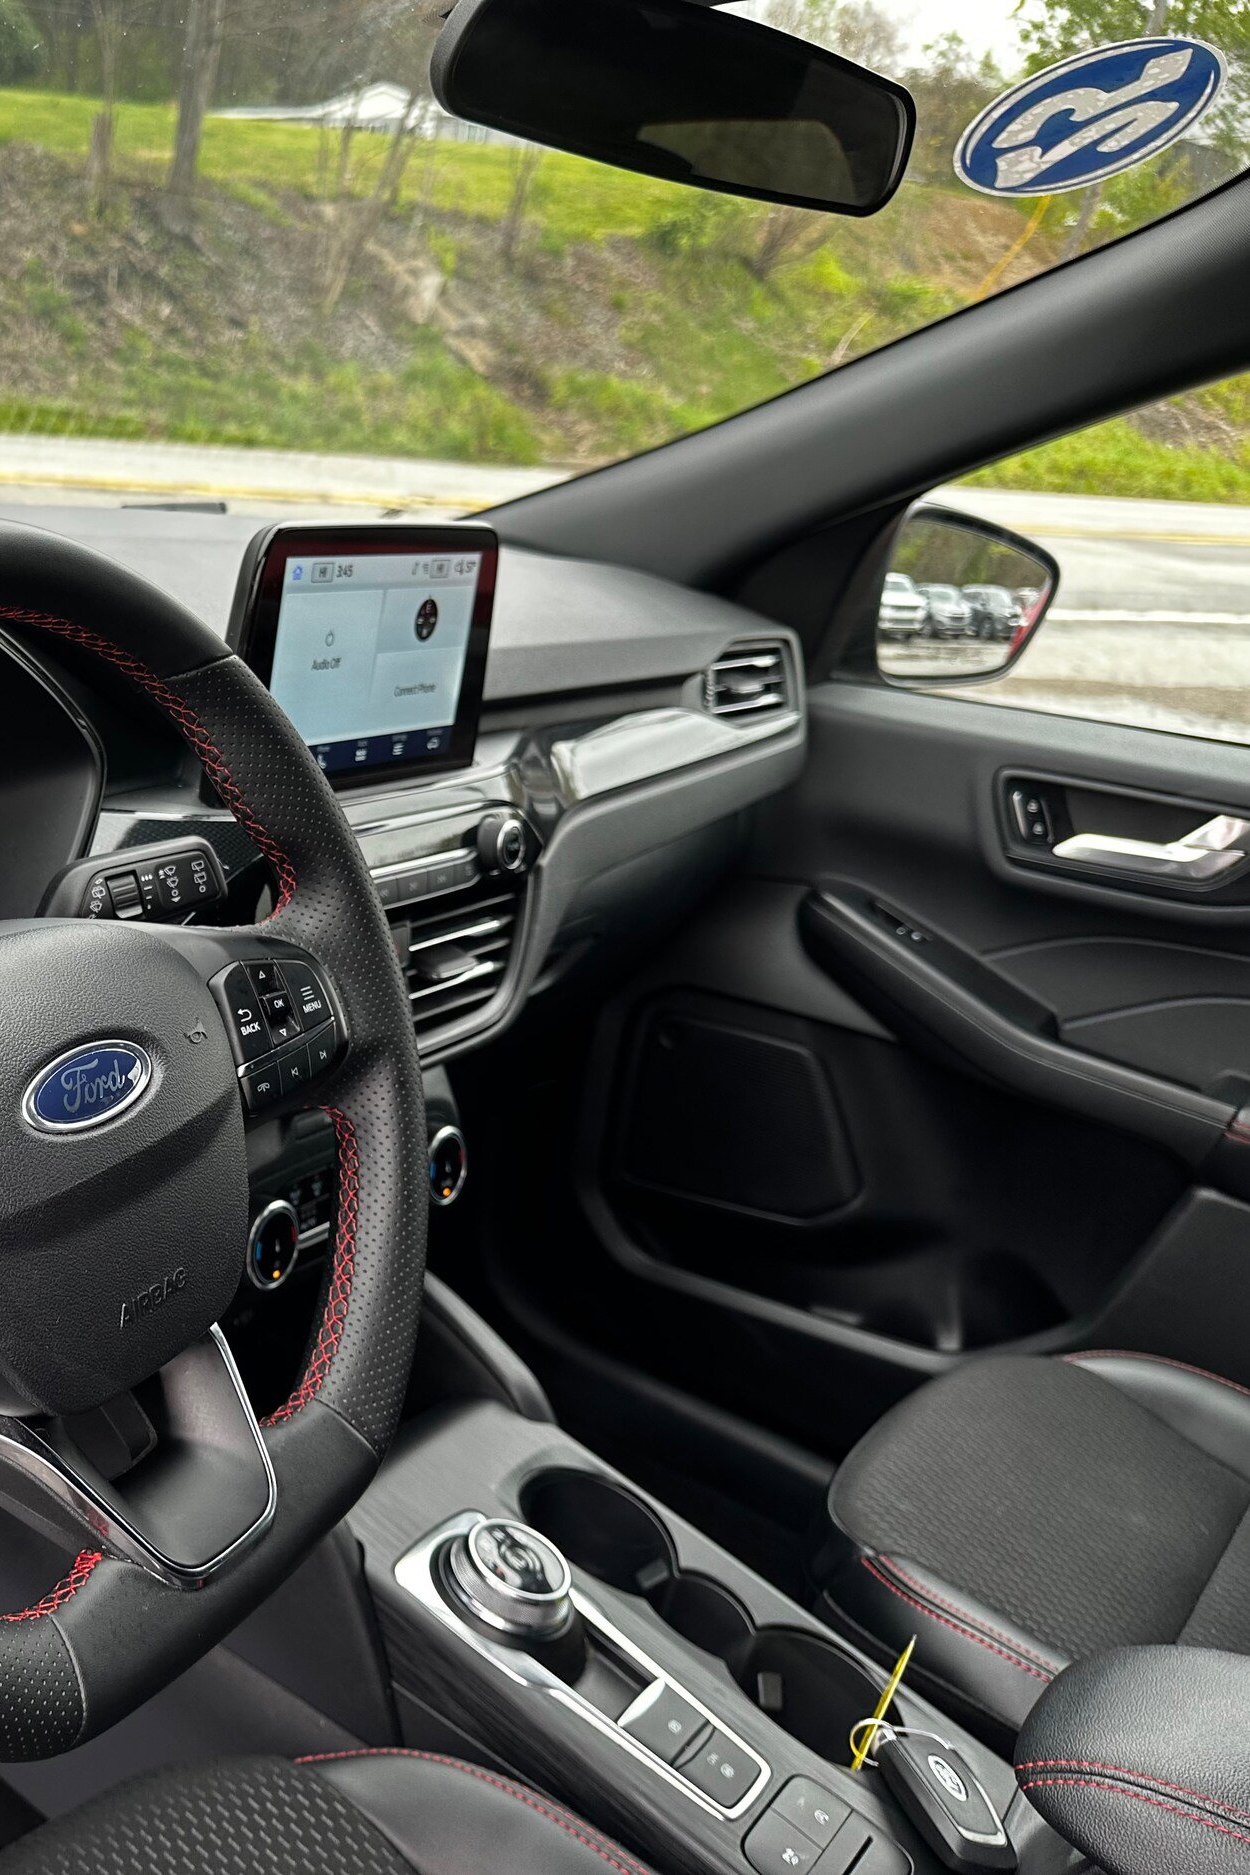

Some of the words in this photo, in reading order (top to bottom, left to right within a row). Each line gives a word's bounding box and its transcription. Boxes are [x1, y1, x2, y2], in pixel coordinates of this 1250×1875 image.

[273, 1000, 285, 1008] OK
[302, 1004, 322, 1014] MENU
[240, 1022, 261, 1036] BACK
[60, 1058, 126, 1113] Ford
[118, 1267, 186, 1330] AIRBAG
